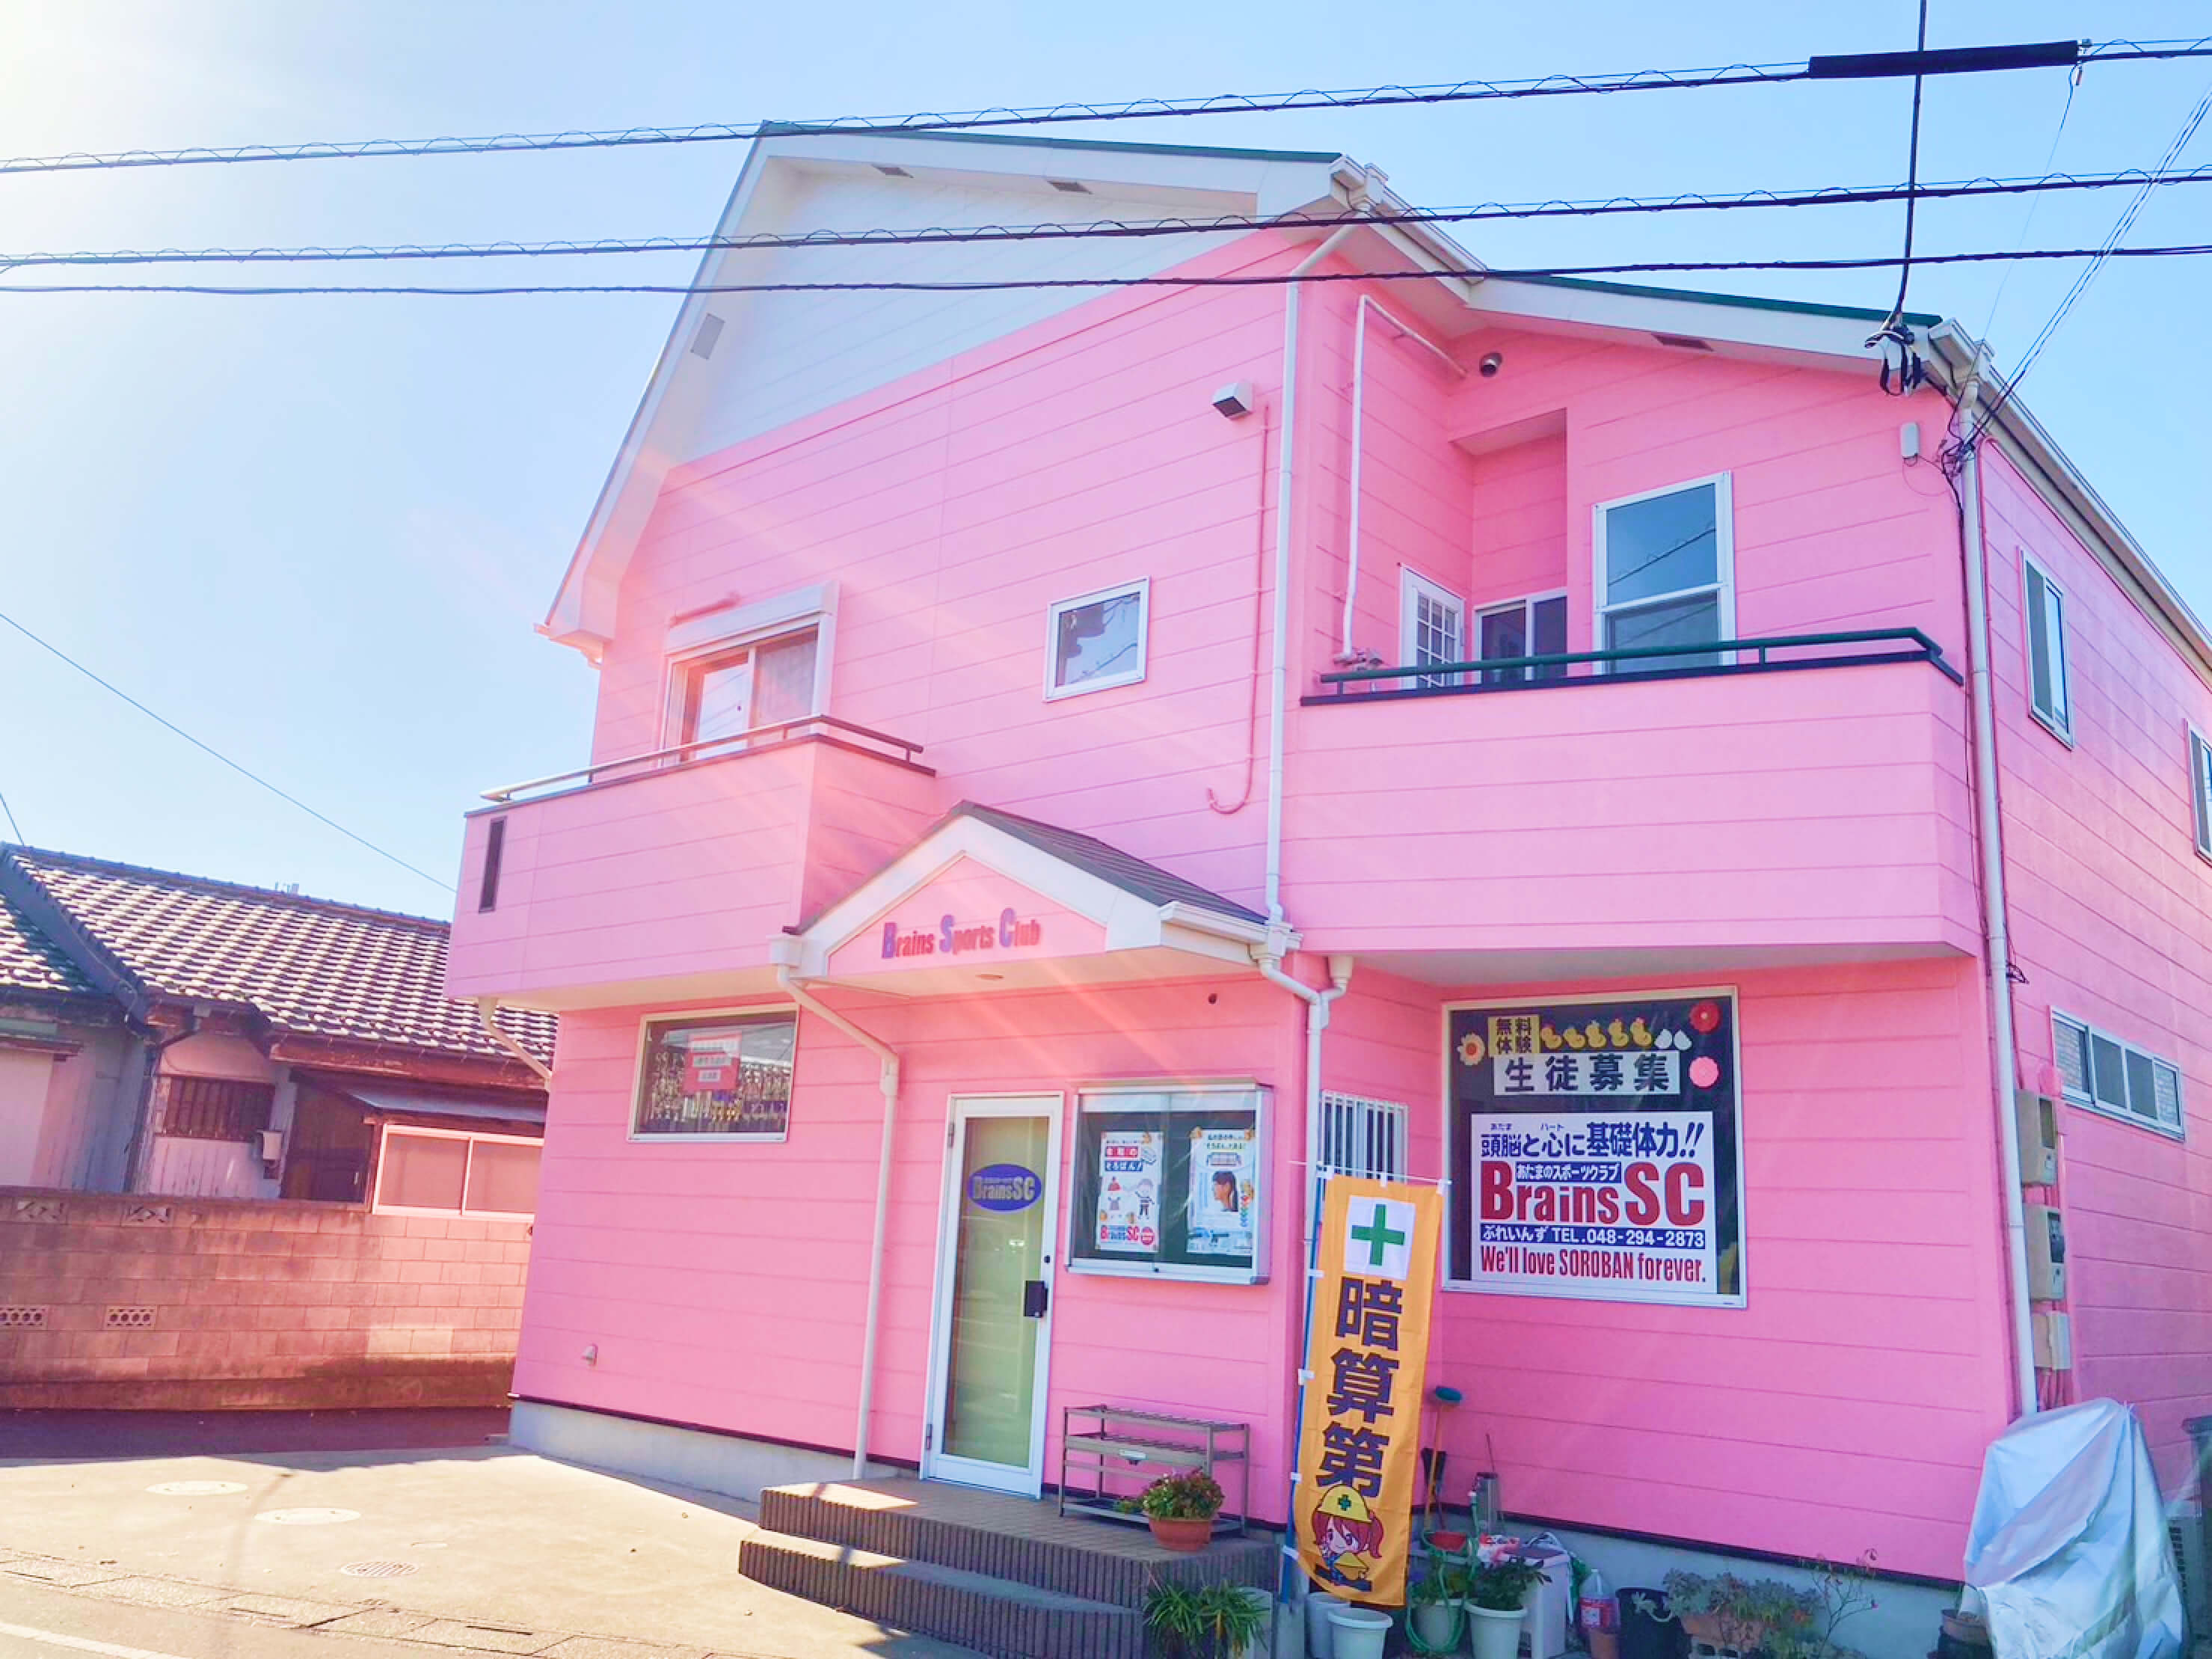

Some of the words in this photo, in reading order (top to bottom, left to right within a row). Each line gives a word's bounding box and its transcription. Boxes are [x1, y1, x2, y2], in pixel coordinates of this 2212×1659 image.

[882, 922, 934, 958] Brains
[939, 915, 995, 955] Sports
[999, 908, 1041, 948] Club
[1496, 1017, 1531, 1035] 無料
[1505, 1053, 1670, 1093] 生徒募集
[1517, 1163, 1620, 1182] あたまのスポーツクラブ
[1483, 1226, 1548, 1242] ぶれいんず
[1481, 1245, 1519, 1273] We'll
[1523, 1247, 1555, 1275] love
[1559, 1249, 1634, 1280] SOROBAN
[1638, 1253, 1706, 1283] forever.
